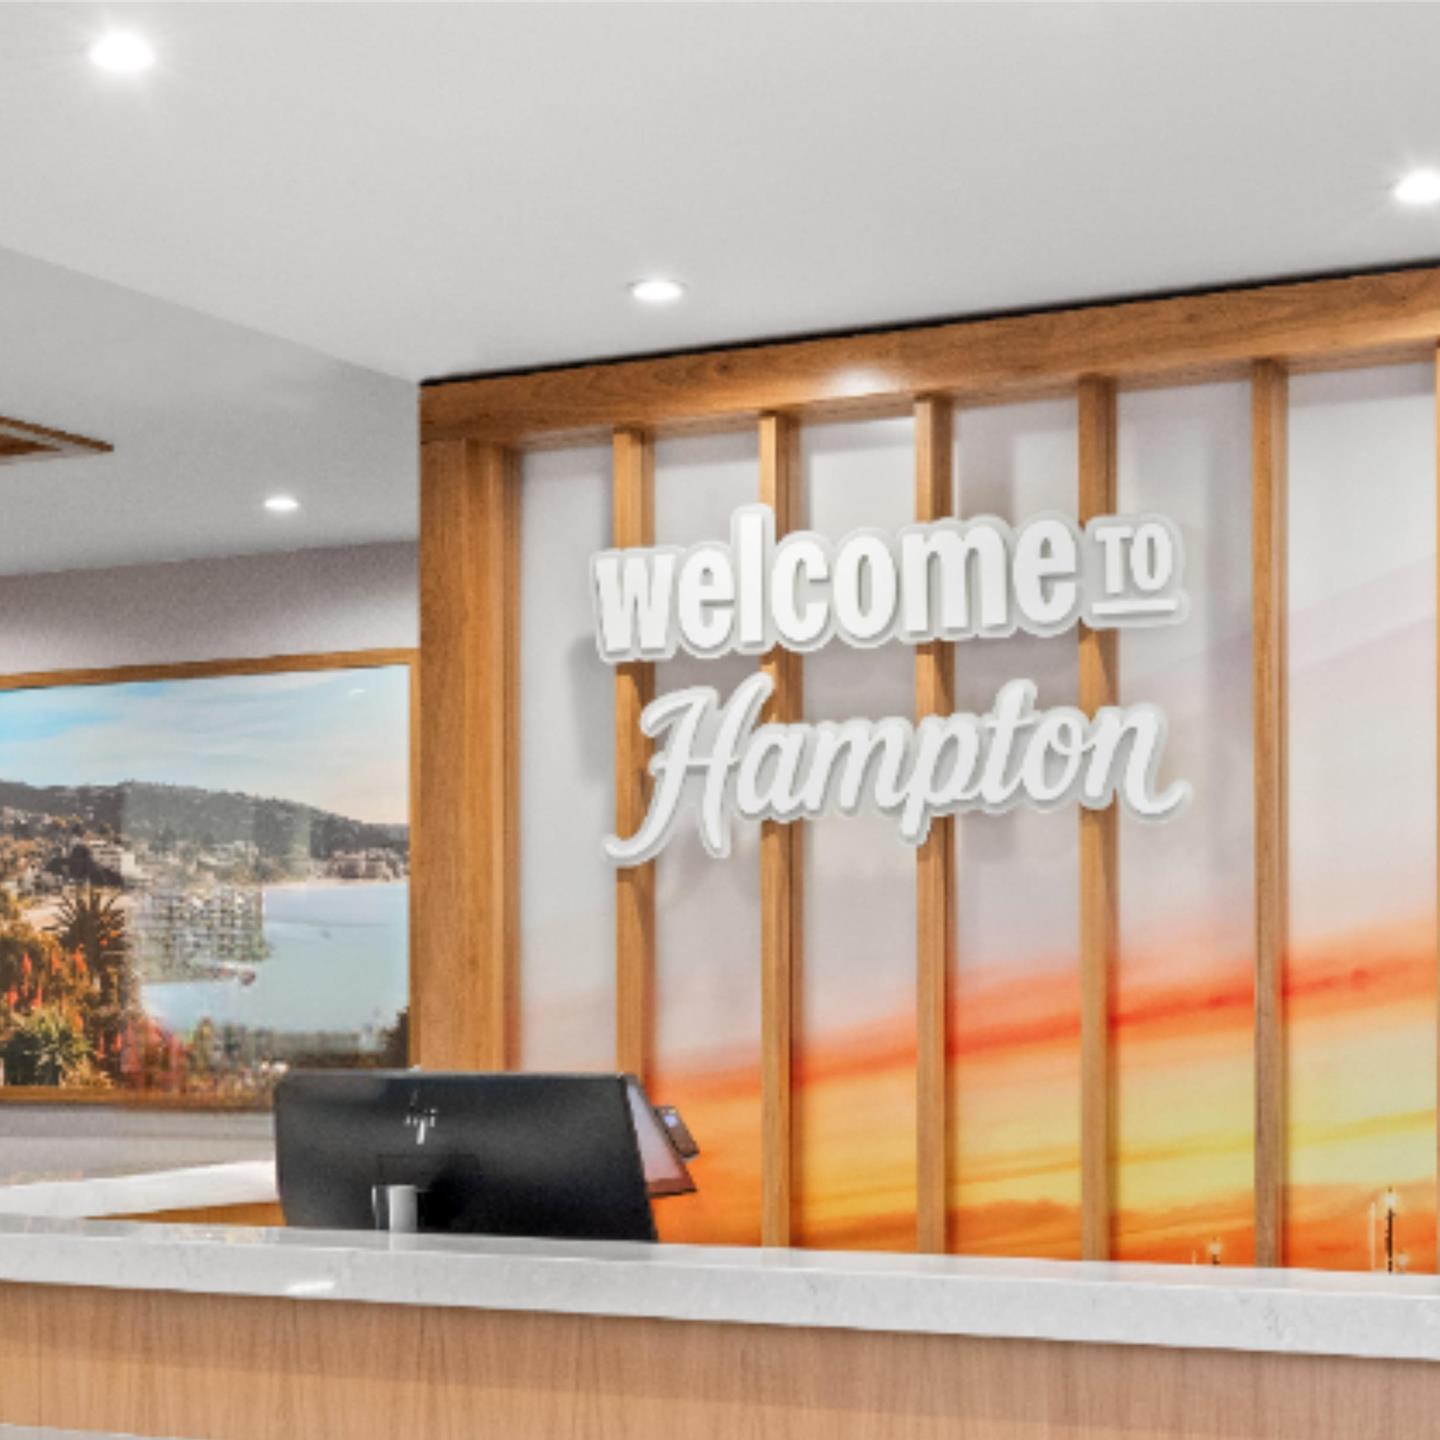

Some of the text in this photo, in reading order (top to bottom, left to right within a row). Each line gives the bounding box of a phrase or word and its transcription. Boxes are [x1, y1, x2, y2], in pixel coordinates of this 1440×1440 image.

[594, 509, 1174, 655] welcome TO
[602, 672, 1193, 861] Hampton
